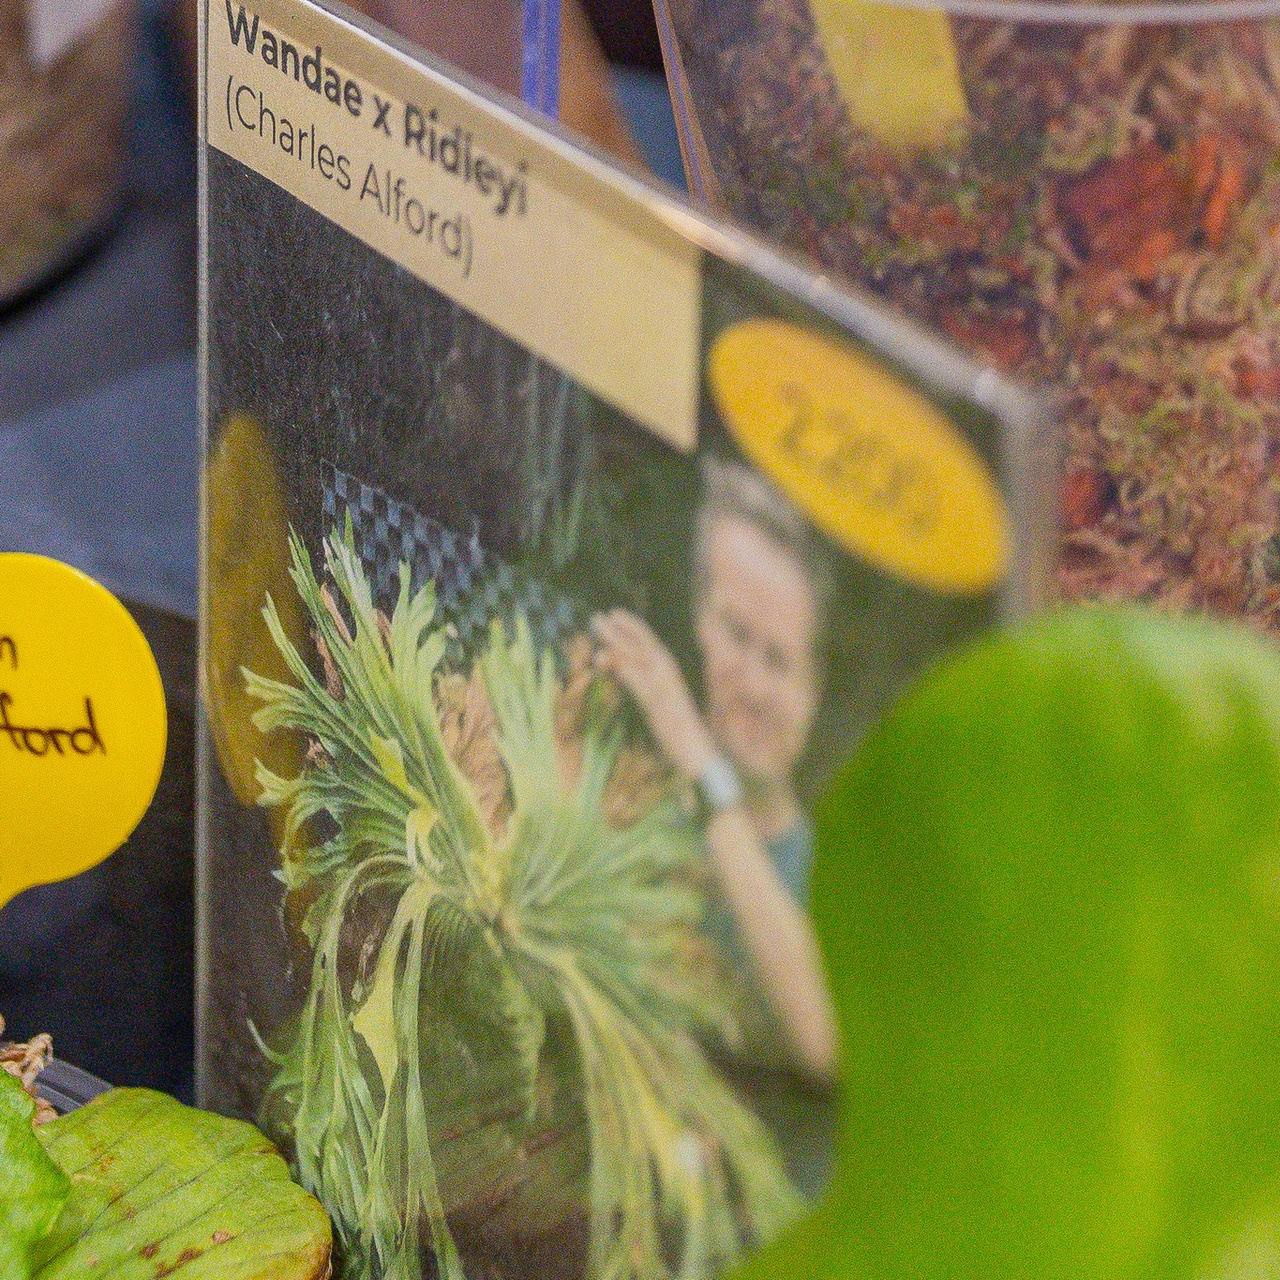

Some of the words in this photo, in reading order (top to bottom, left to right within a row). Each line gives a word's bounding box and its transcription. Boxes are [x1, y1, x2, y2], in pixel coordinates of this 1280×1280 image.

[225, 74, 352, 191] (Charles
[360, 162, 474, 279] Alford)
[372, 90, 392, 136] x
[403, 103, 531, 215] Ridleyi
[0, 691, 107, 758] ford
